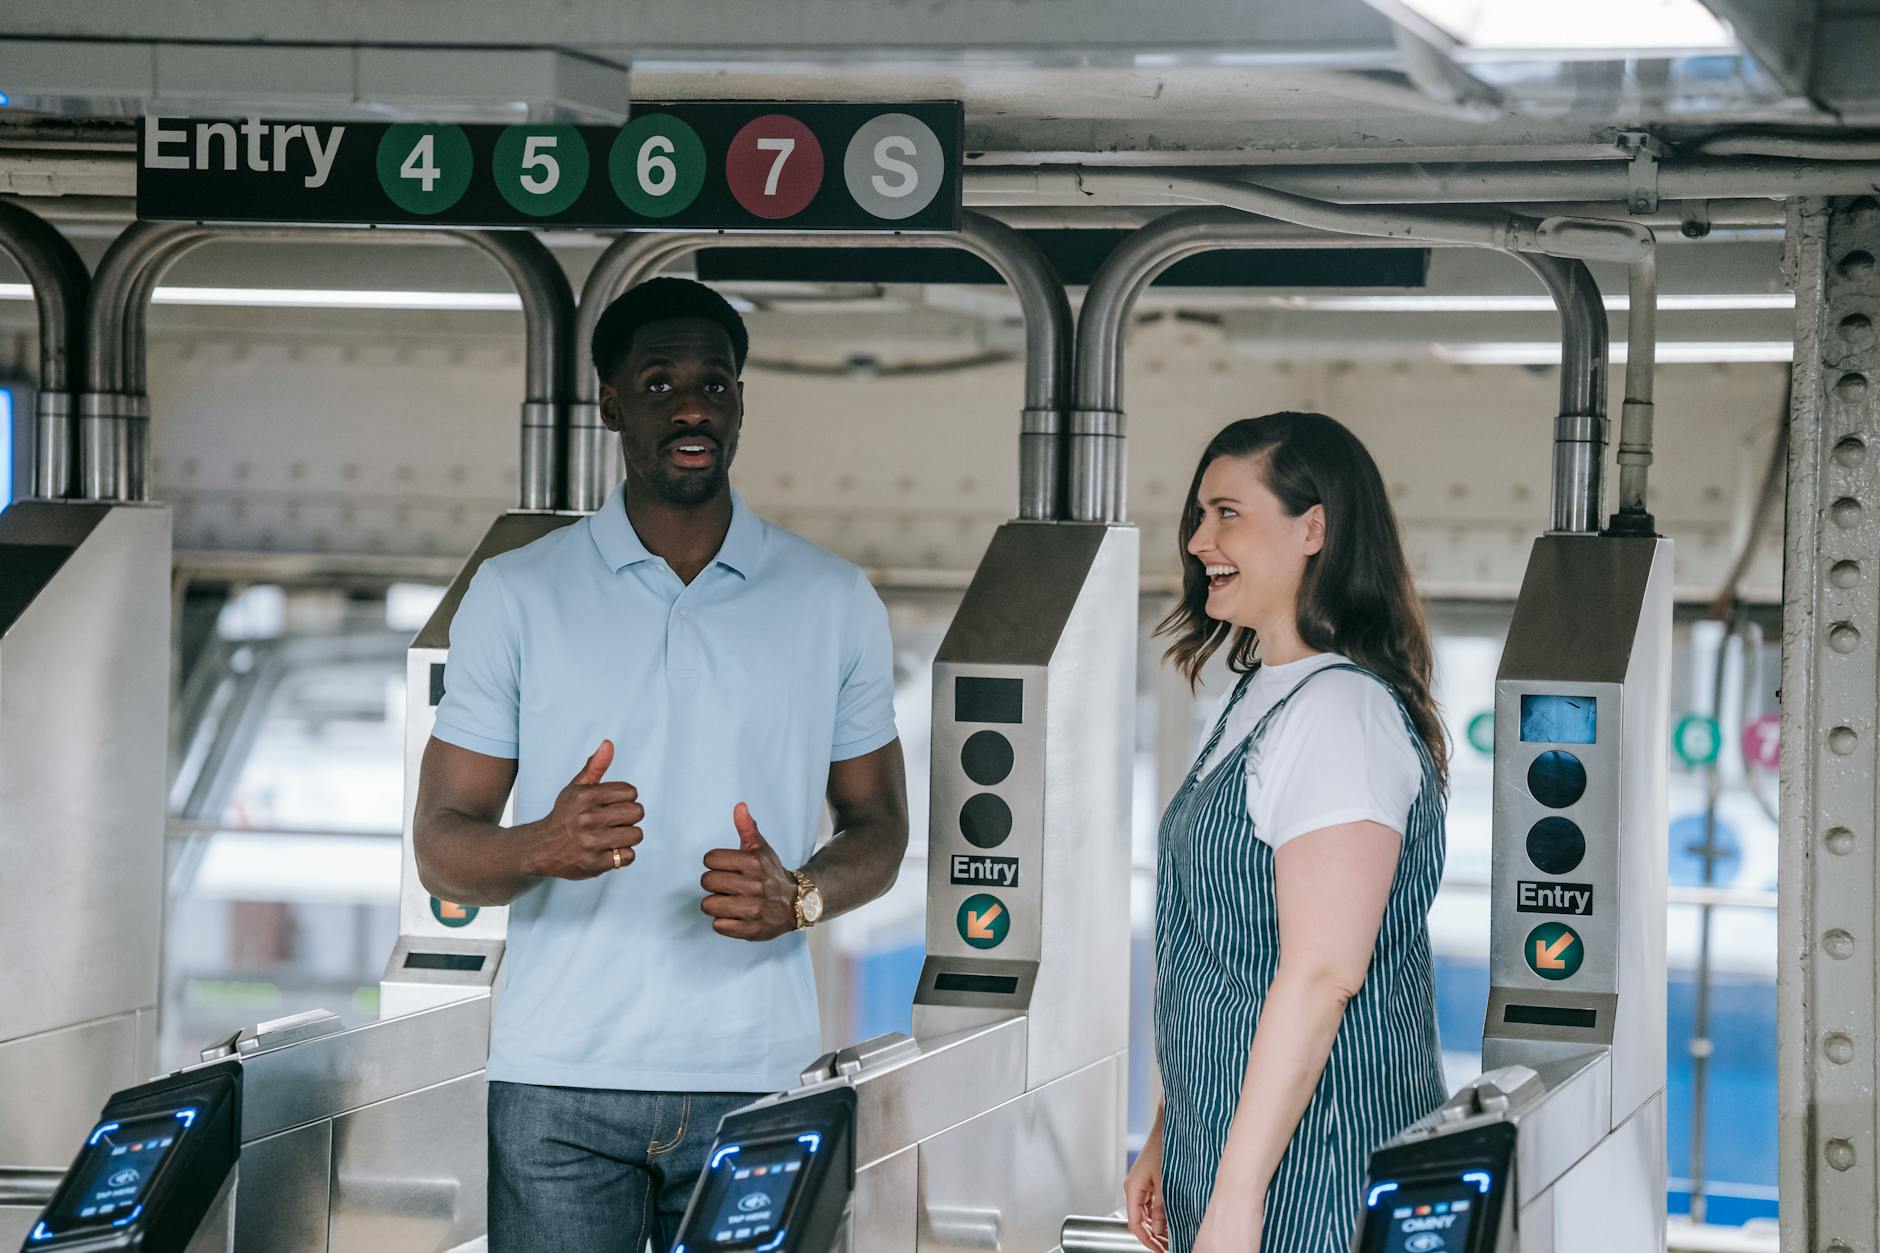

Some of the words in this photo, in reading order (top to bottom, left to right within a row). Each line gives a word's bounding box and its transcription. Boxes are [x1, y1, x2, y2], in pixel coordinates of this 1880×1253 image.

[144, 115, 346, 188] Entry
[400, 134, 441, 192] 4
[519, 136, 560, 195] 5
[636, 135, 677, 196] 6
[757, 138, 795, 195] 7
[871, 135, 919, 197] S
[953, 857, 1017, 885] Entry
[1519, 883, 1591, 914] Entry
